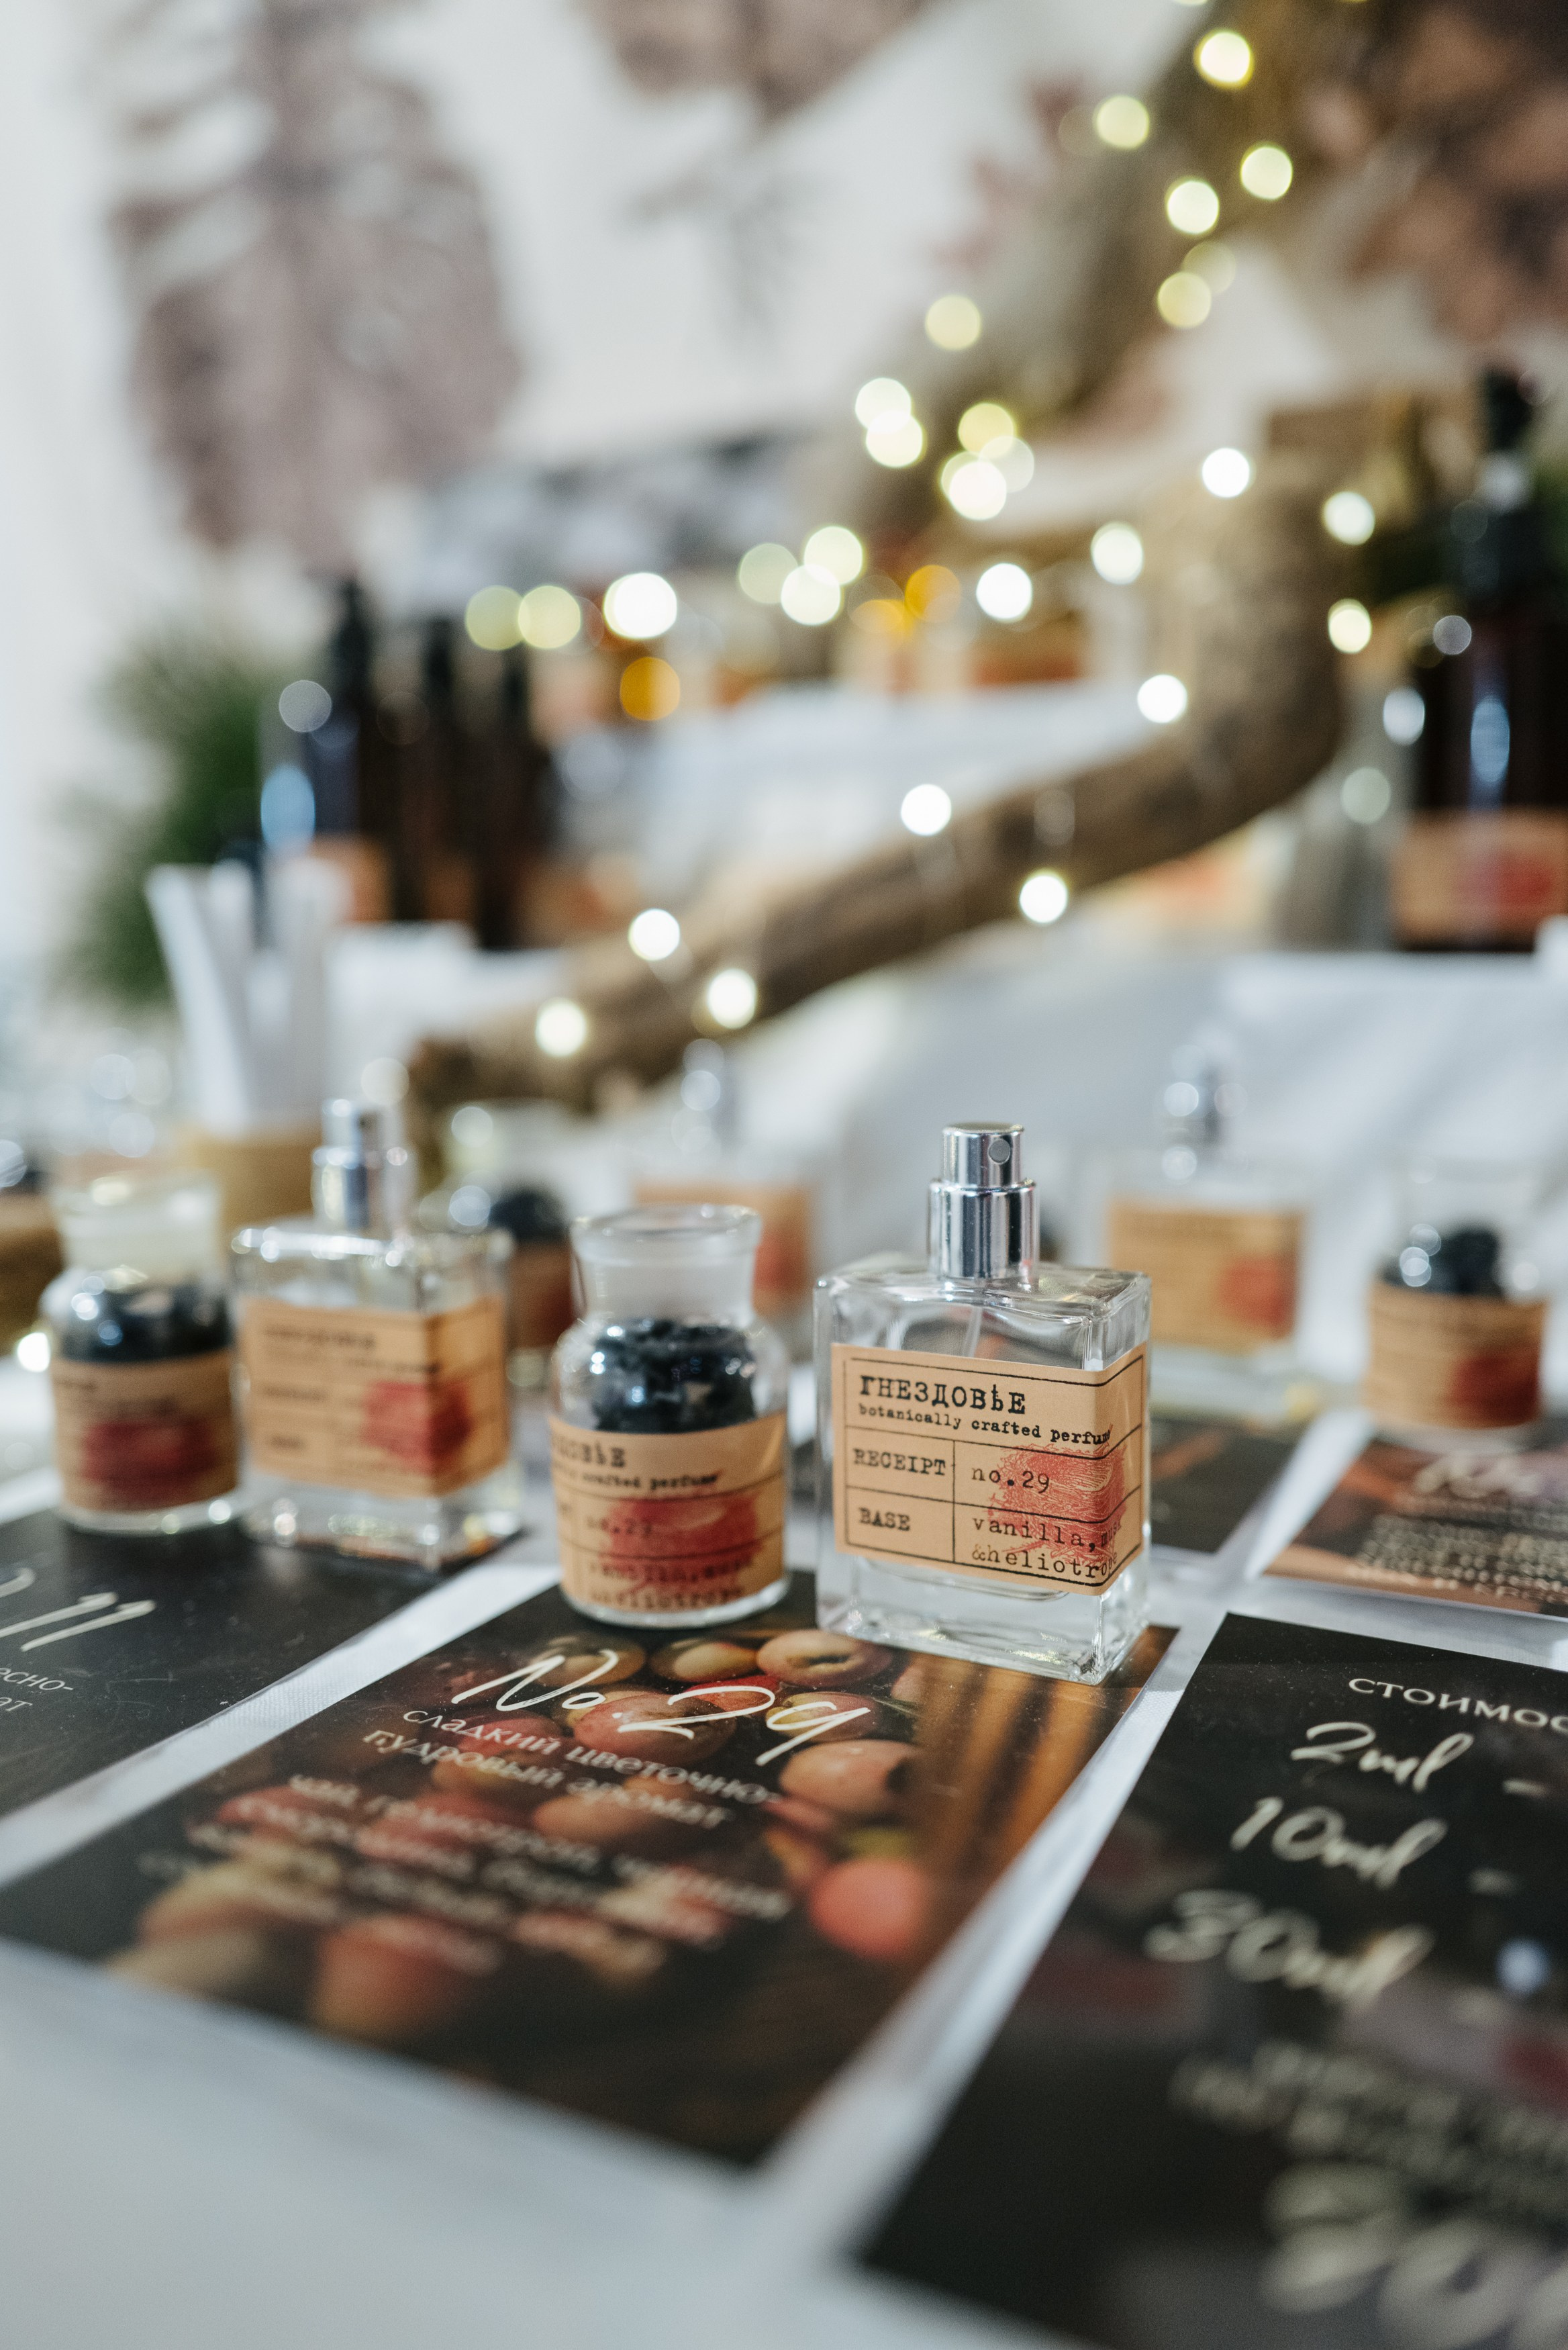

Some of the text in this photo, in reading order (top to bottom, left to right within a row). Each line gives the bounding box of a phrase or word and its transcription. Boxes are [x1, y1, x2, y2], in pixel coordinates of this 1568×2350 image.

[859, 1402, 962, 1430] botanically
[971, 1418, 1042, 1439] crafted
[852, 1448, 946, 1476] RECEIPT
[859, 1507, 911, 1532] BASE
[1289, 1720, 1475, 1793] 2ml
[1230, 1795, 1449, 1890] 10ml
